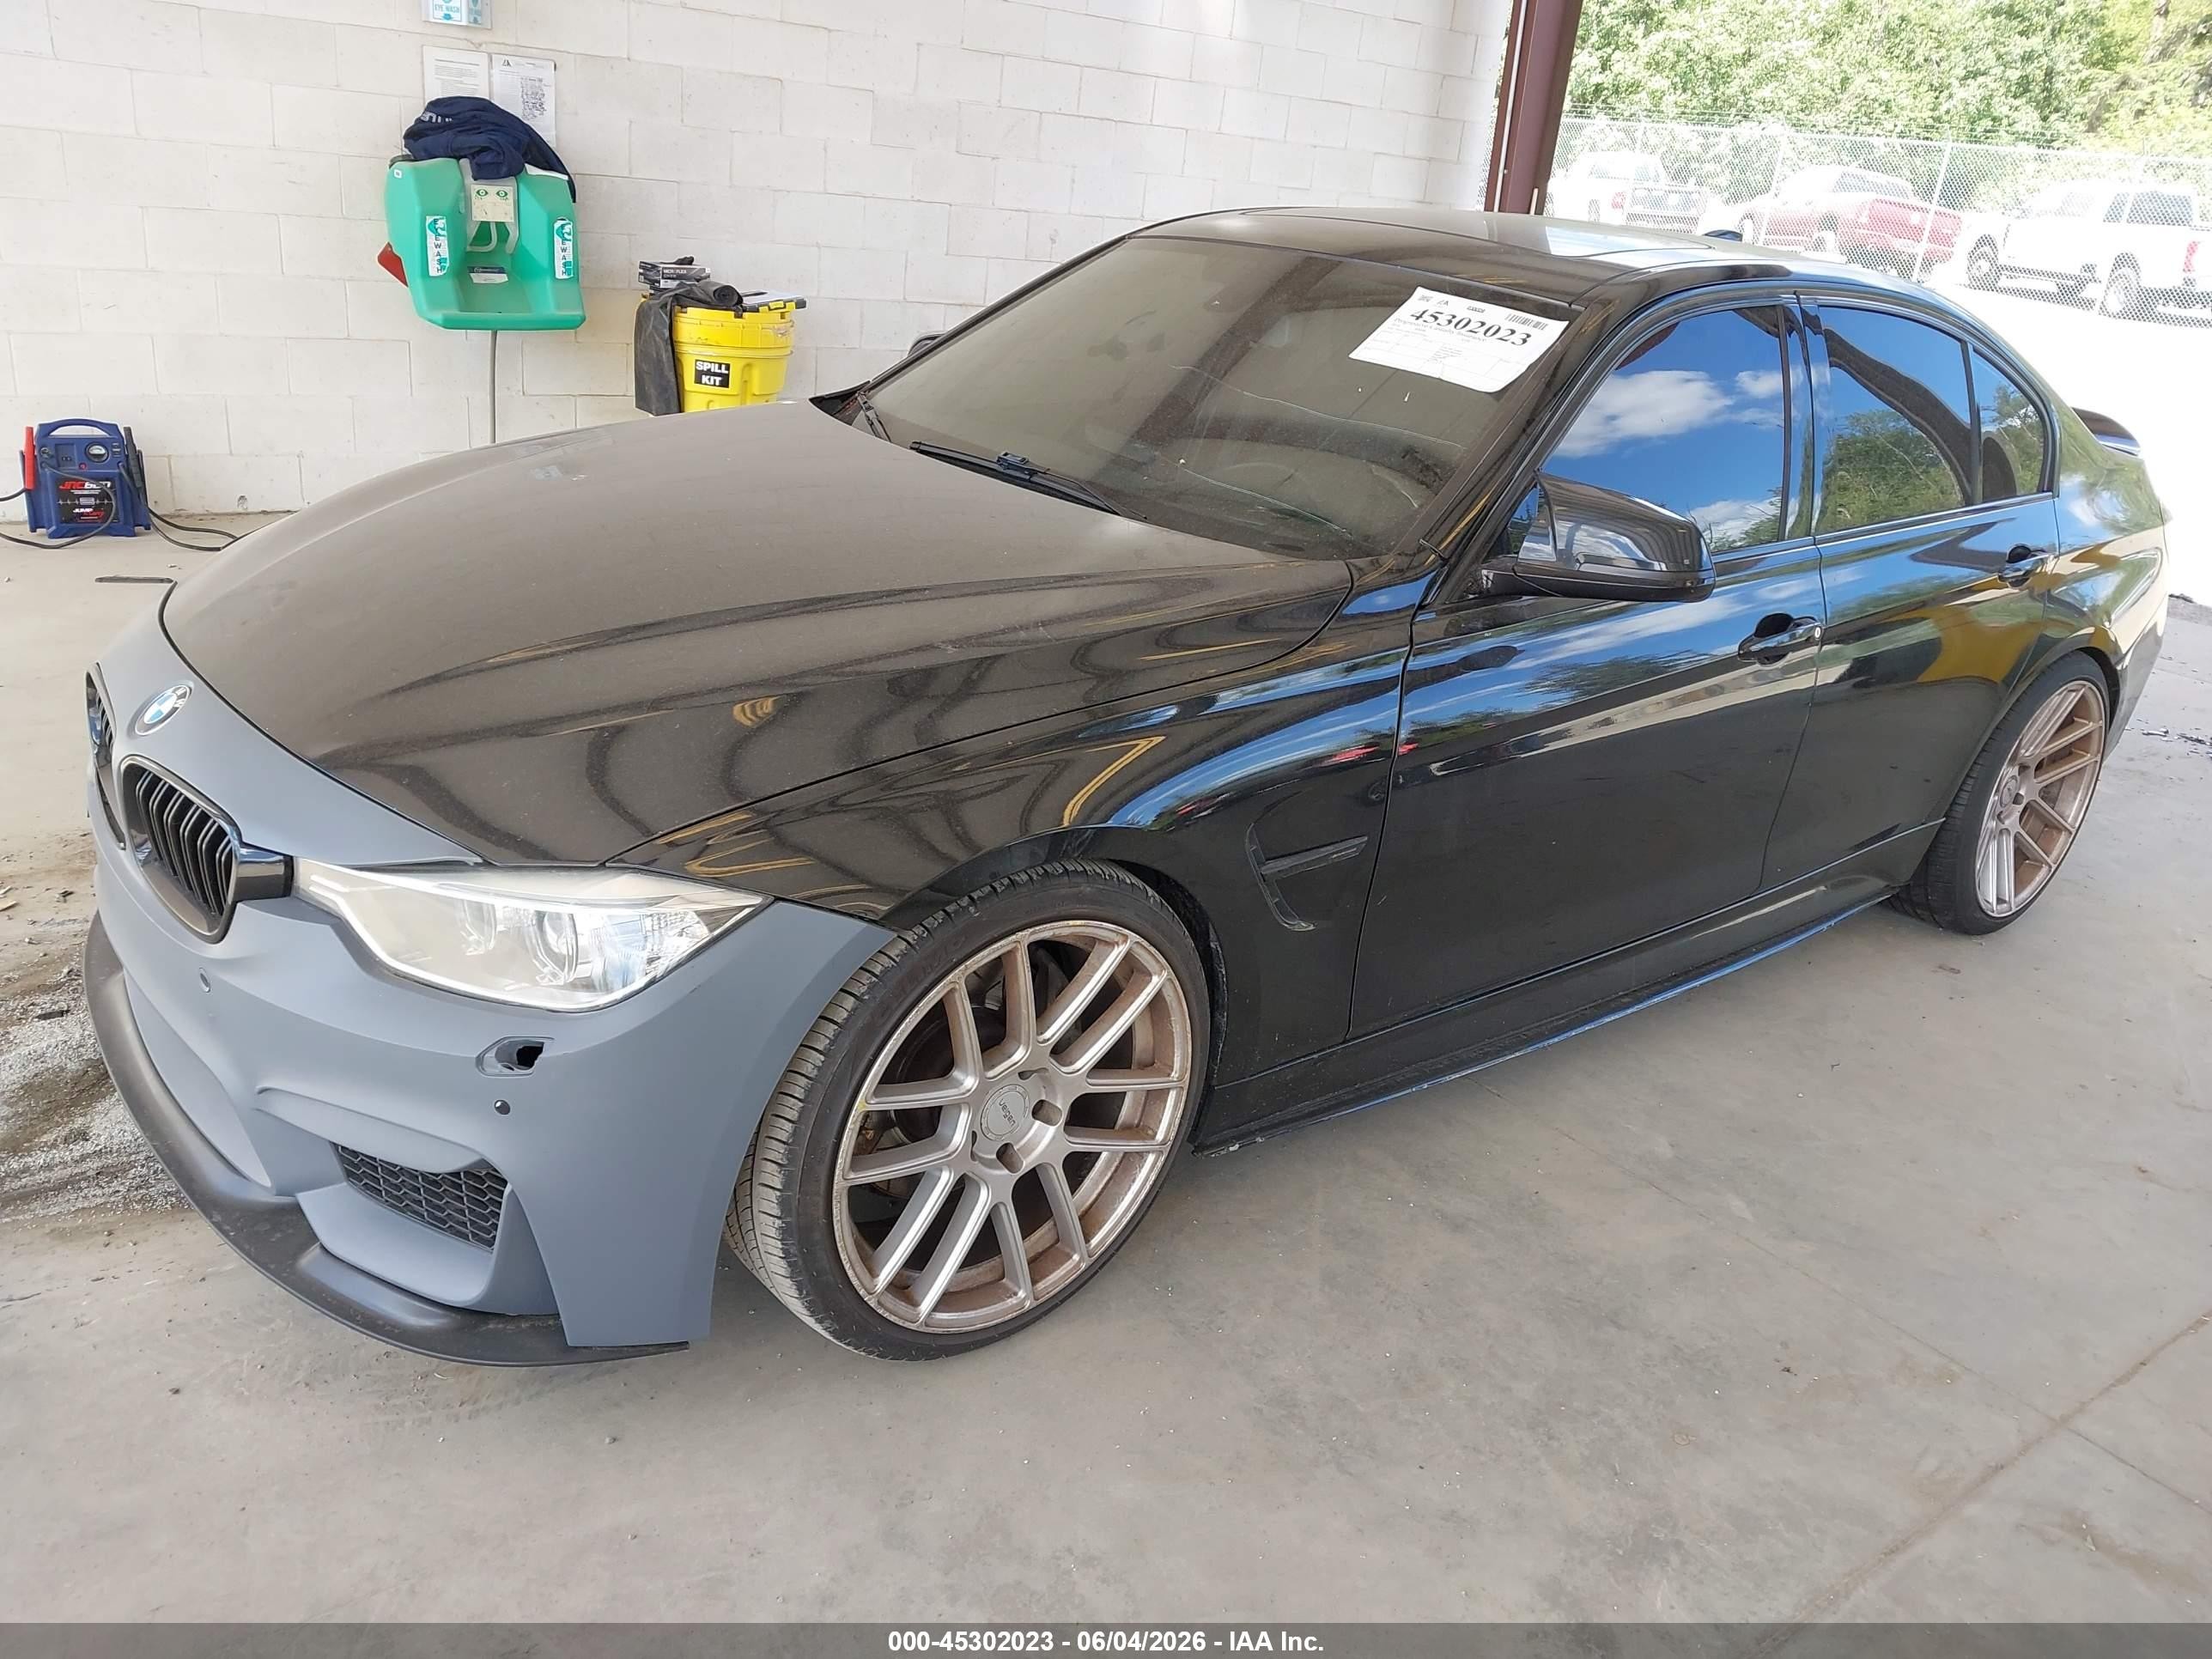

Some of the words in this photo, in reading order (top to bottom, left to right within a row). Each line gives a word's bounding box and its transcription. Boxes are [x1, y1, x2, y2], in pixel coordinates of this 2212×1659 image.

[1410, 308, 1532, 346] 45302023
[696, 361, 729, 374] SPILL
[701, 374, 722, 386] KIT
